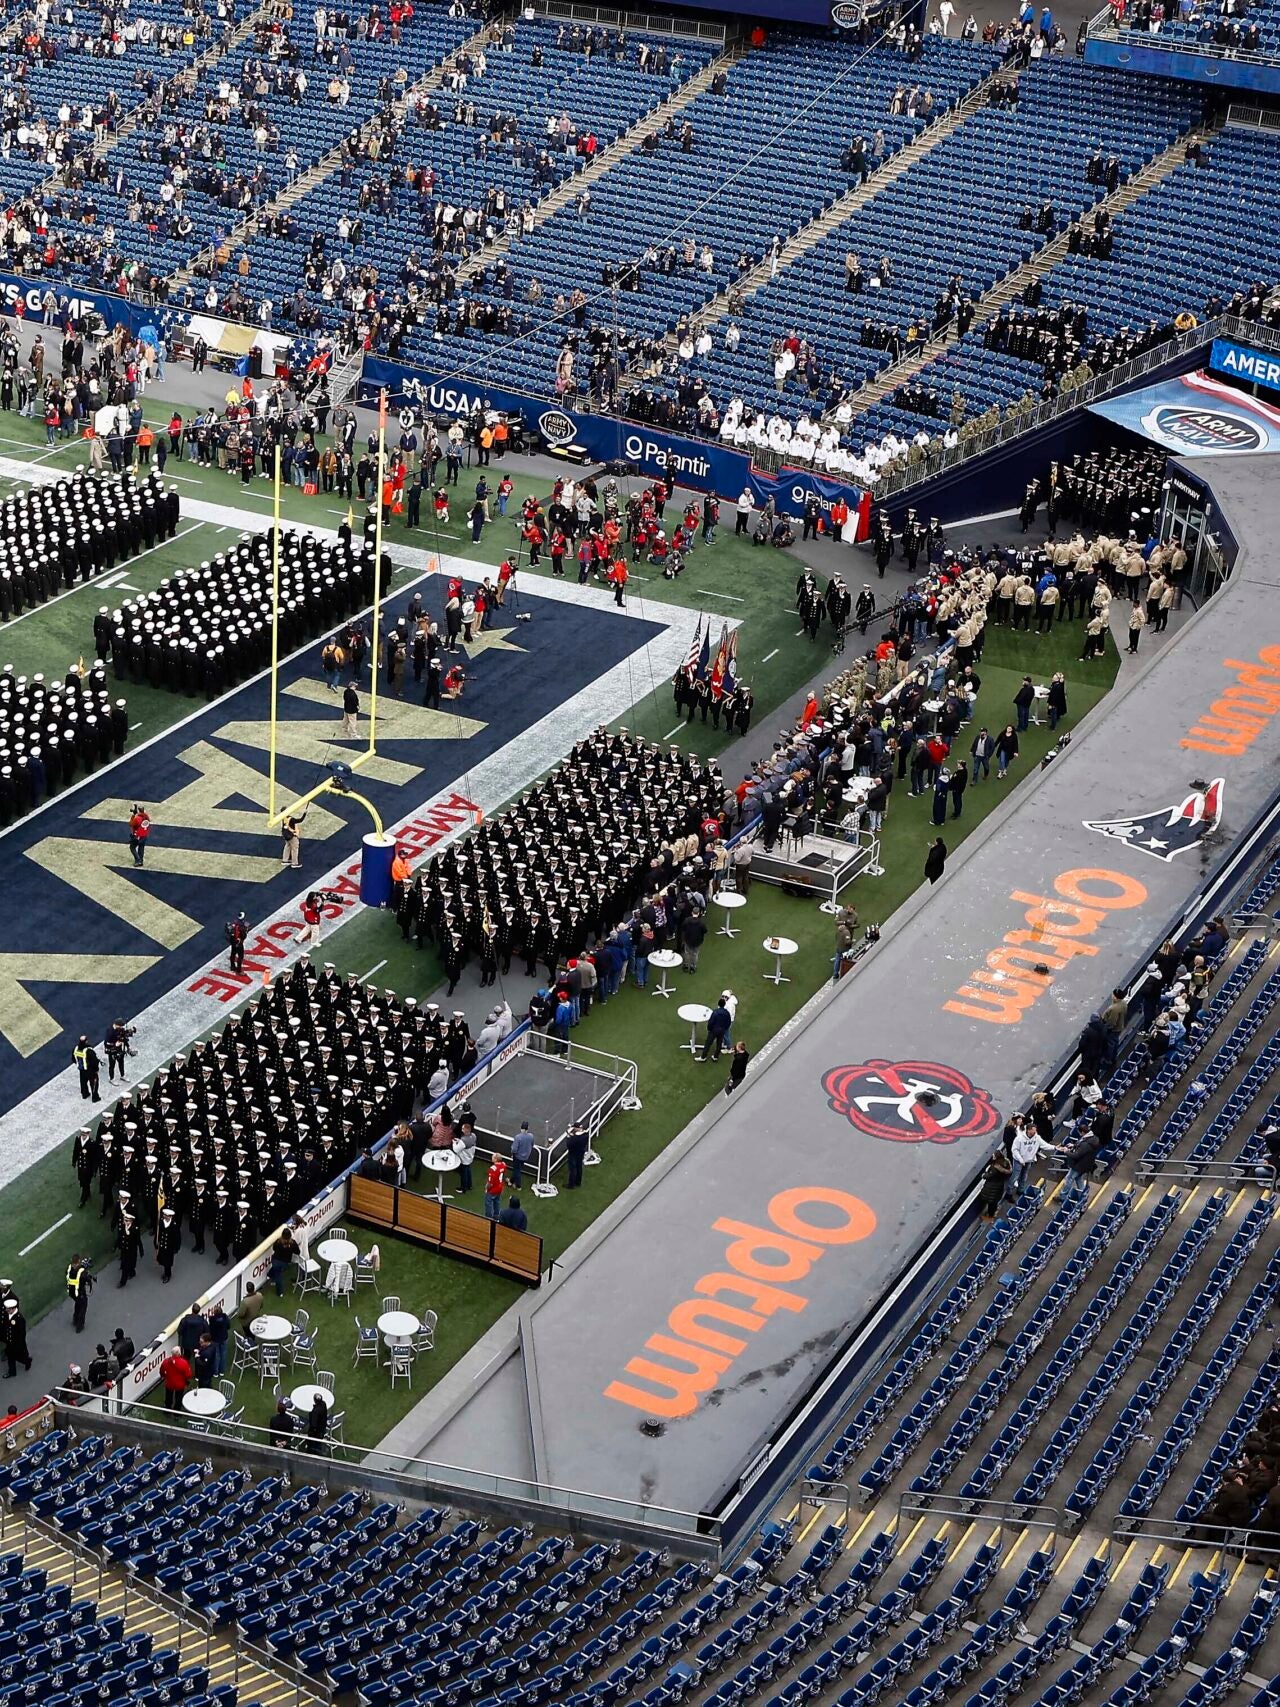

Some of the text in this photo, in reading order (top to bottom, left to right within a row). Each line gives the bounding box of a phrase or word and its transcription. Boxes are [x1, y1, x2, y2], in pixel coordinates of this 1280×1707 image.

[547, 426, 567, 437] NAVY
[548, 415, 567, 427] ARMY
[1164, 422, 1226, 445] NAVY
[1188, 415, 1257, 439] ARMY
[941, 868, 1149, 1025] Optum
[499, 1037, 524, 1062] Optum
[454, 1077, 479, 1102] Optum
[602, 1186, 877, 1418] Optum
[133, 1350, 167, 1385] Optum
